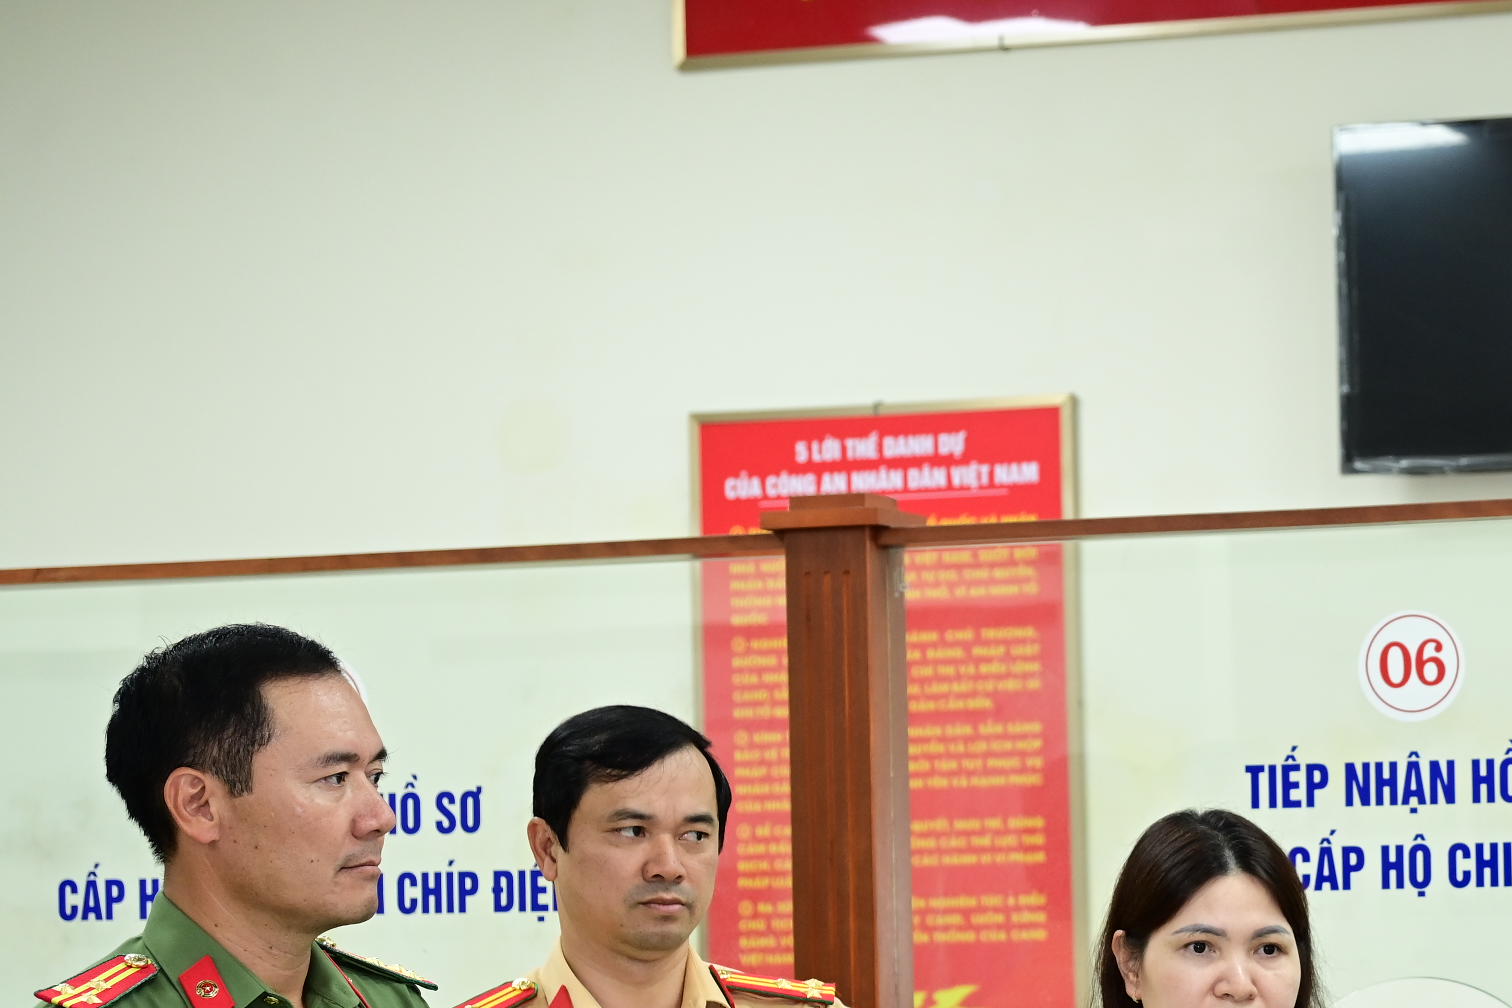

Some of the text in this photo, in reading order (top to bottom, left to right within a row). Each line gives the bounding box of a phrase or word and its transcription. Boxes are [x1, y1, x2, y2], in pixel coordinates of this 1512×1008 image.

[820, 472, 848, 494] AN
[993, 461, 1040, 484] NAM
[1379, 638, 1446, 689] 06
[1245, 746, 1329, 809] TIẾP
[1344, 751, 1456, 814] NHẬN
[435, 786, 482, 834] SƠ
[58, 862, 125, 921] CẤP
[397, 859, 479, 914] CHÍP
[492, 863, 558, 922] ĐIỆ
[1287, 829, 1366, 891] CẤP
[1380, 833, 1432, 897] HỘ
